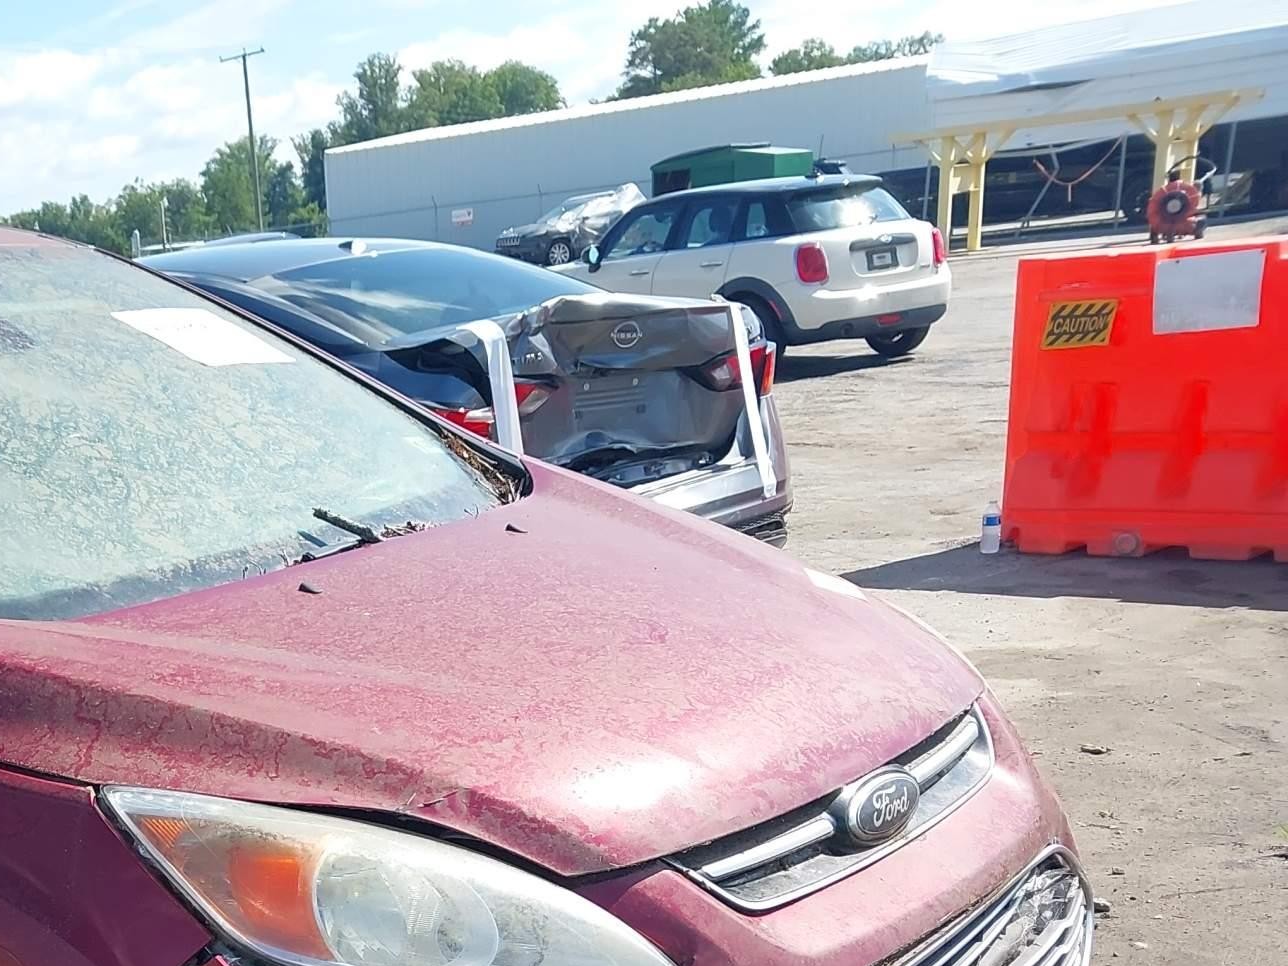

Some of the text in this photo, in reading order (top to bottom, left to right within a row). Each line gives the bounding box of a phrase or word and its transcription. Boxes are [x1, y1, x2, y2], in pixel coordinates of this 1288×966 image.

[1053, 316, 1106, 333] CAUTION
[610, 331, 644, 339] NISSAN
[872, 784, 910, 828] Ford
